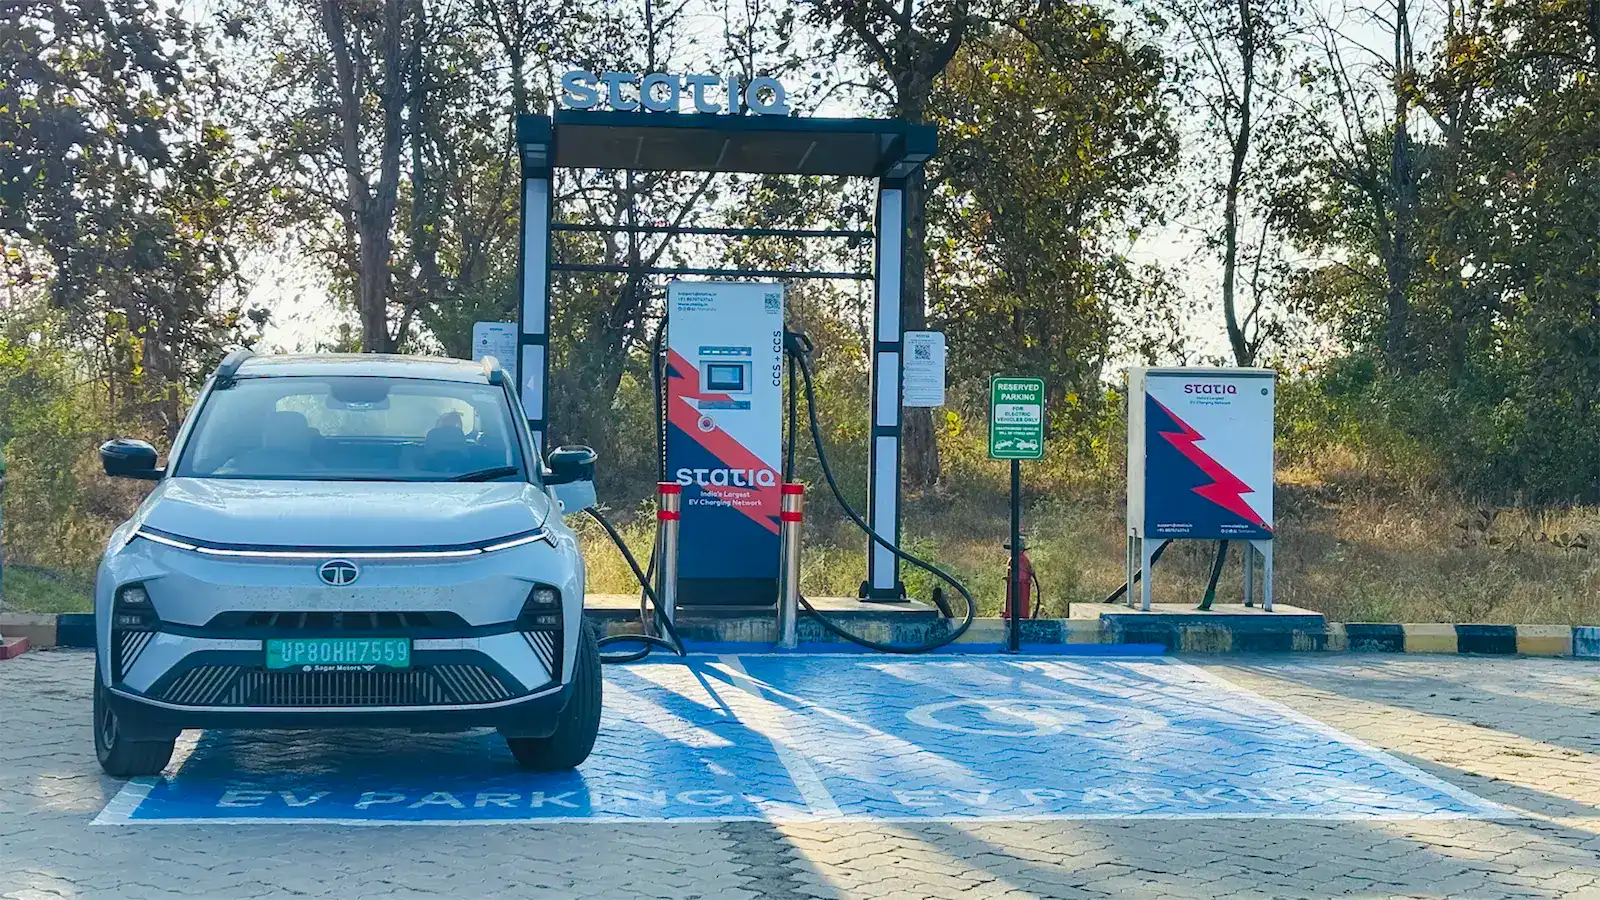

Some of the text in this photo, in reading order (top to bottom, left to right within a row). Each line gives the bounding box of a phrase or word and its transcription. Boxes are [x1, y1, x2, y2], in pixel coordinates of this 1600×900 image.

[1001, 393, 1036, 401] PARKING
[700, 490, 751, 499] India's Largest
[689, 498, 700, 506] EV
[701, 498, 732, 507] Charging
[281, 641, 407, 662] UP80HH7559
[314, 664, 336, 672] Sagar
[215, 789, 734, 809] EV PARKING
[893, 788, 991, 807] EV
